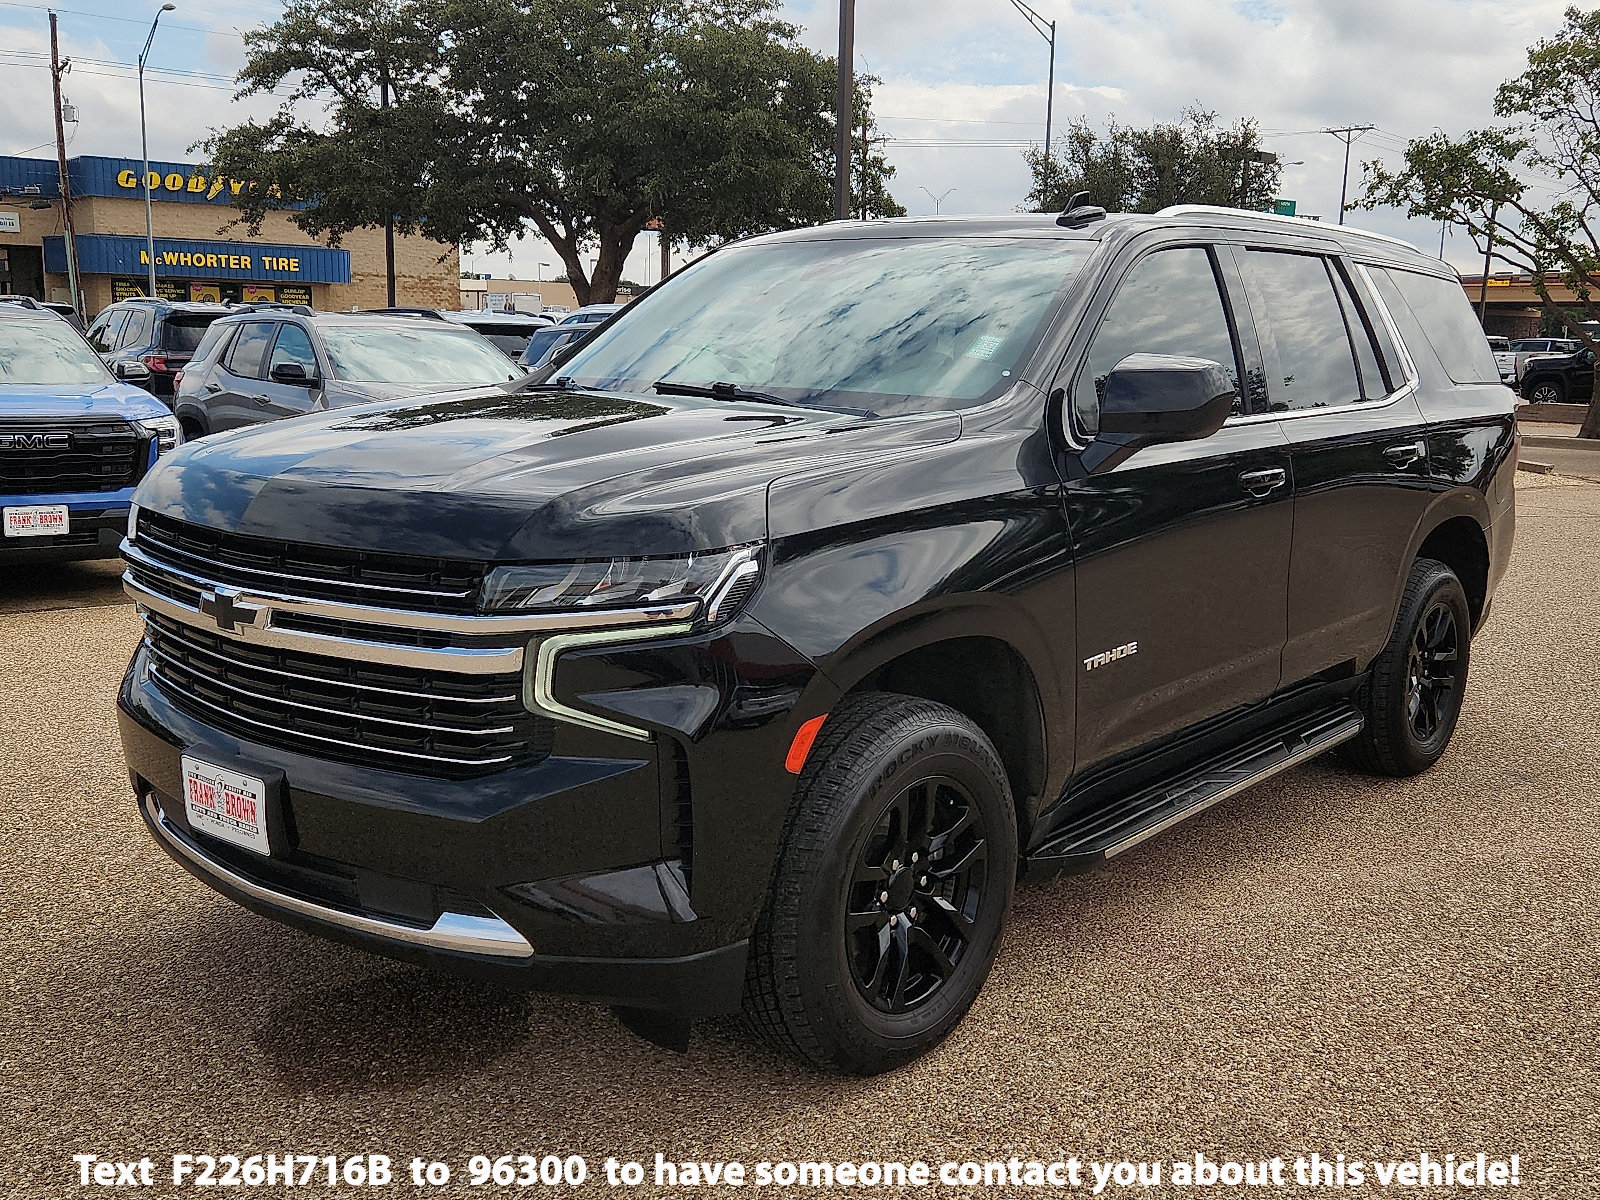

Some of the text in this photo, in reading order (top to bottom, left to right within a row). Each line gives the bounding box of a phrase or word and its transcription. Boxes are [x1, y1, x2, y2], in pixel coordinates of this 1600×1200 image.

[140, 250, 300, 272] McWHORTER TIRE
[0, 434, 69, 449] GMC
[9, 514, 63, 525] FRANK BROWN
[1083, 641, 1138, 671] TAHOE
[187, 778, 216, 810] FRANK
[224, 791, 257, 827] BROWN
